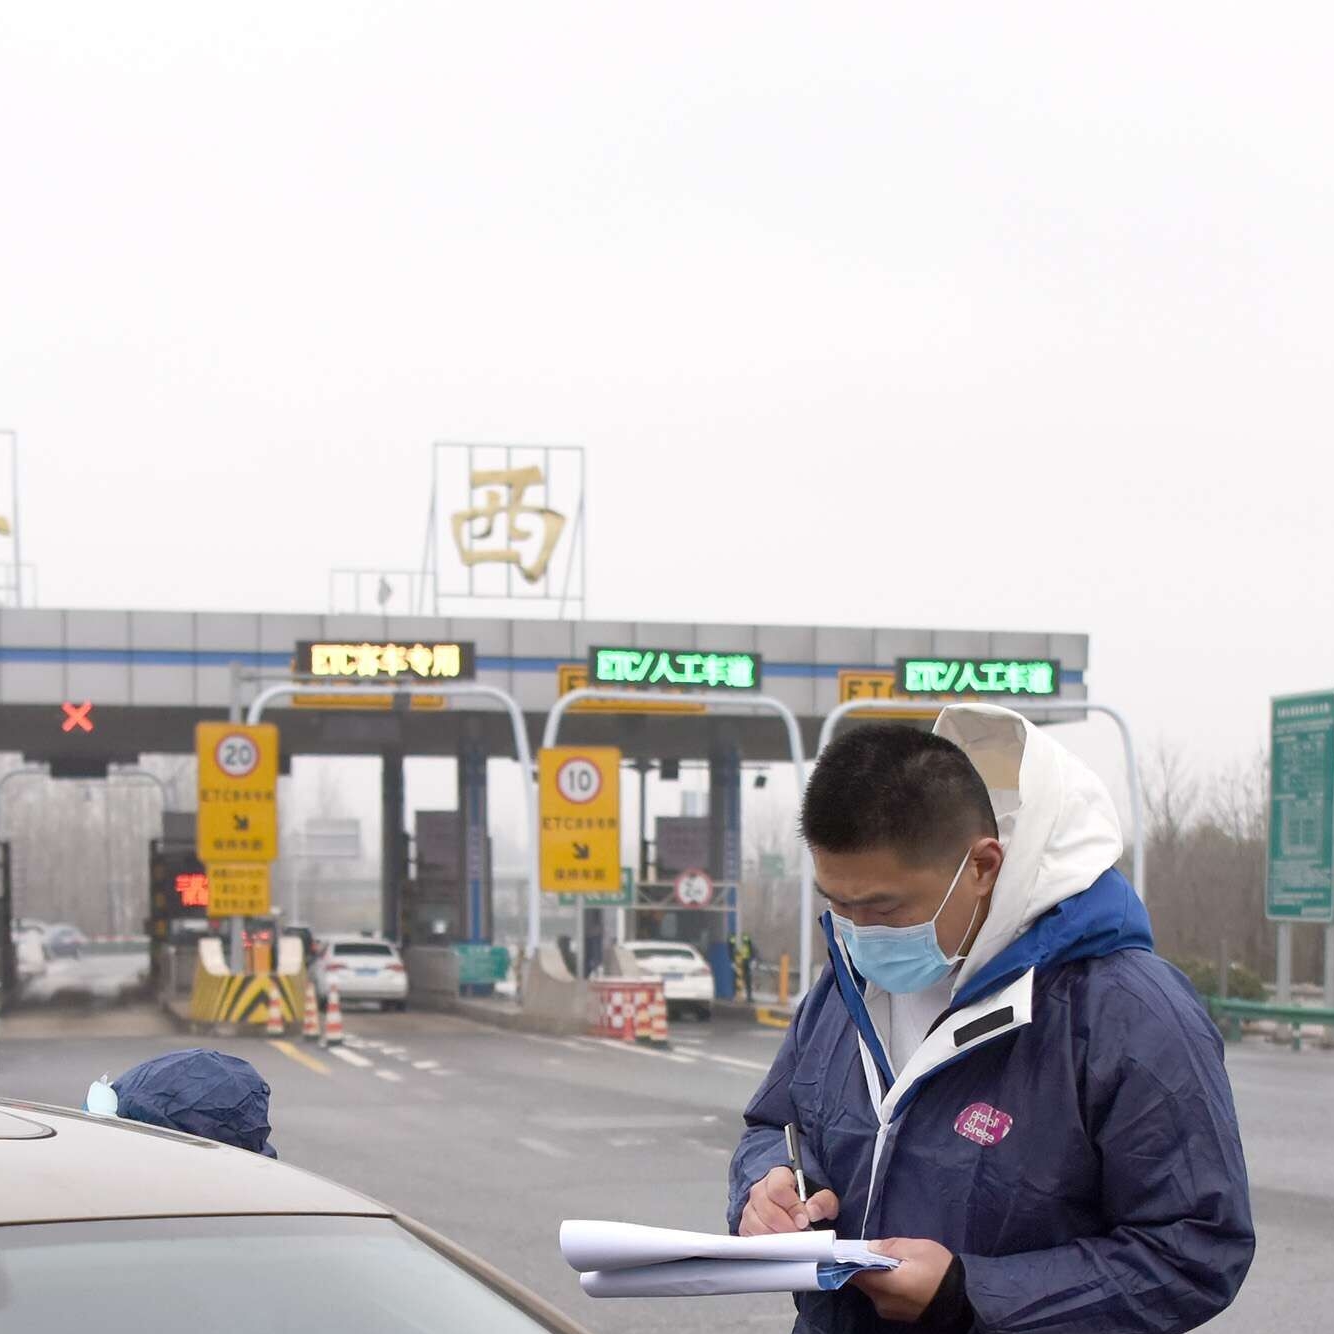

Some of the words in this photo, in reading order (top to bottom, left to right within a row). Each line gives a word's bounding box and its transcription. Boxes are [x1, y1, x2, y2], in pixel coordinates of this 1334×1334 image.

[597, 650, 755, 687] ETC/人工车道
[905, 661, 1053, 693] ETC/人工车道
[224, 743, 253, 766] 20
[568, 769, 592, 792] 10
